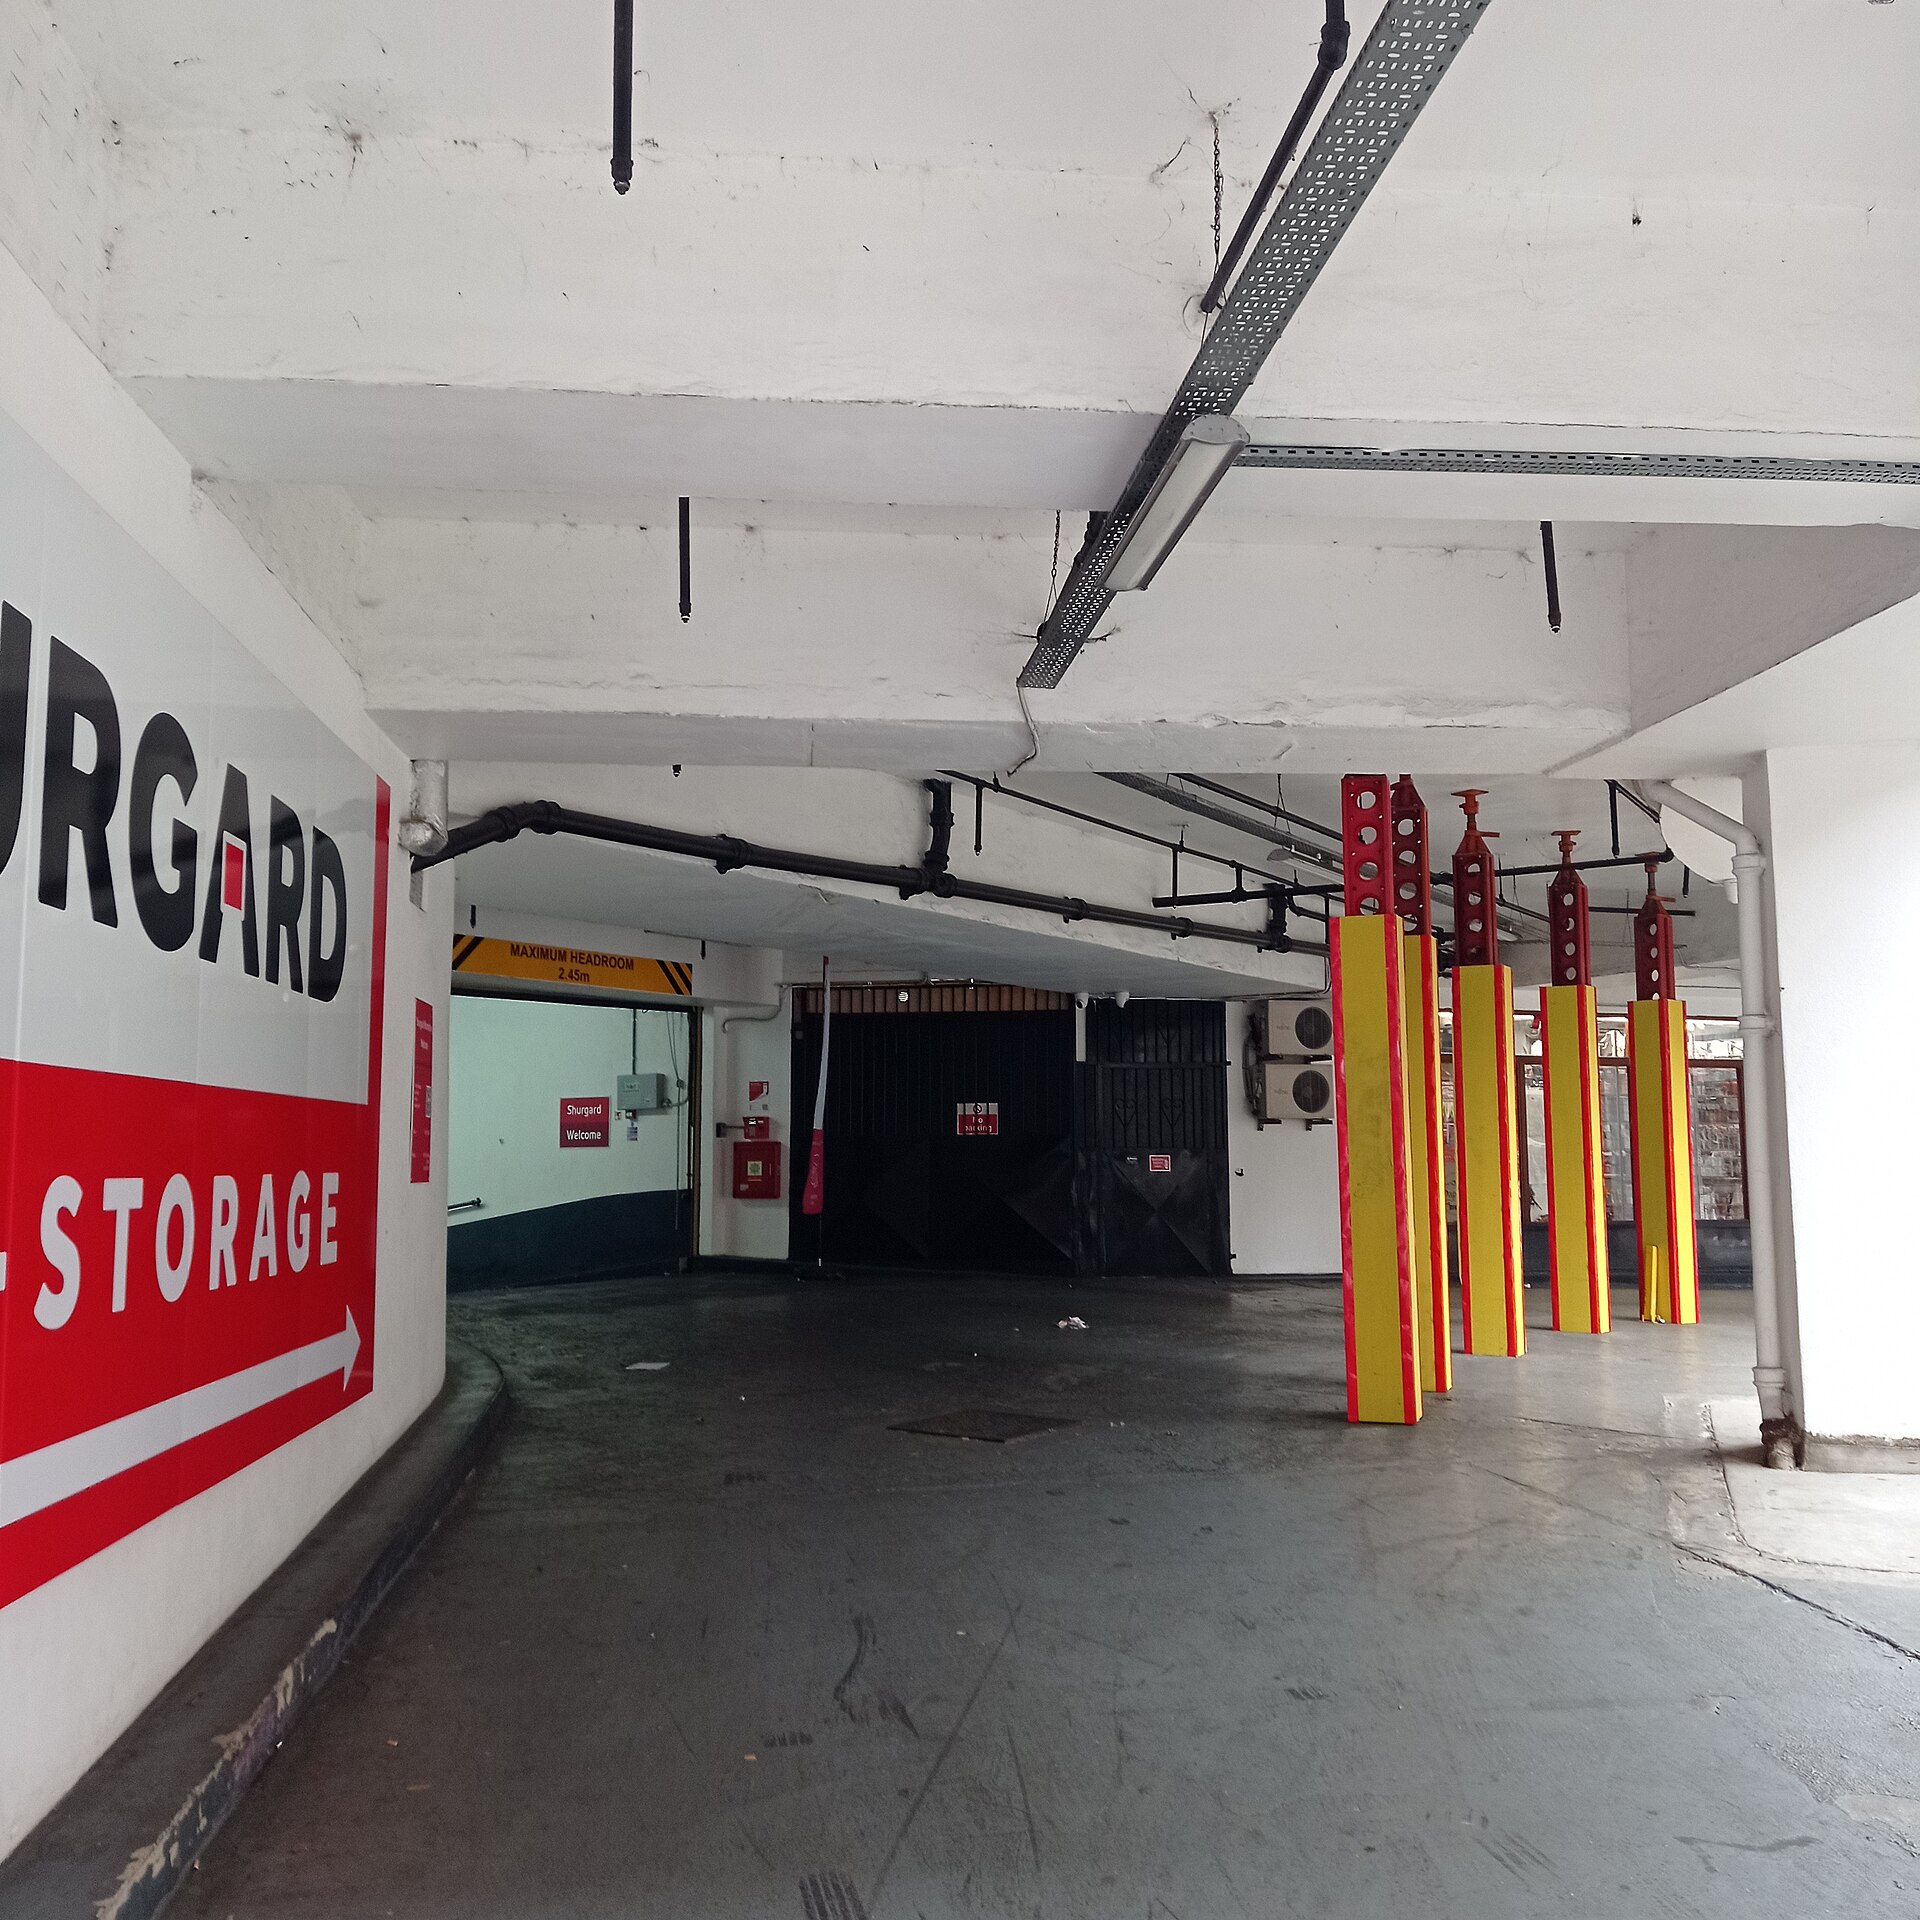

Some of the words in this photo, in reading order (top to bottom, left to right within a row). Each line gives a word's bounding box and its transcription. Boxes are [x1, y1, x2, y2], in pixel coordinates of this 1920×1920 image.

[510, 944, 567, 961] MAXIMUM
[570, 952, 634, 970] HEADROOM
[558, 967, 590, 982] 2.45m
[566, 1104, 602, 1118] Shurgard
[566, 1129, 602, 1141] Welcome
